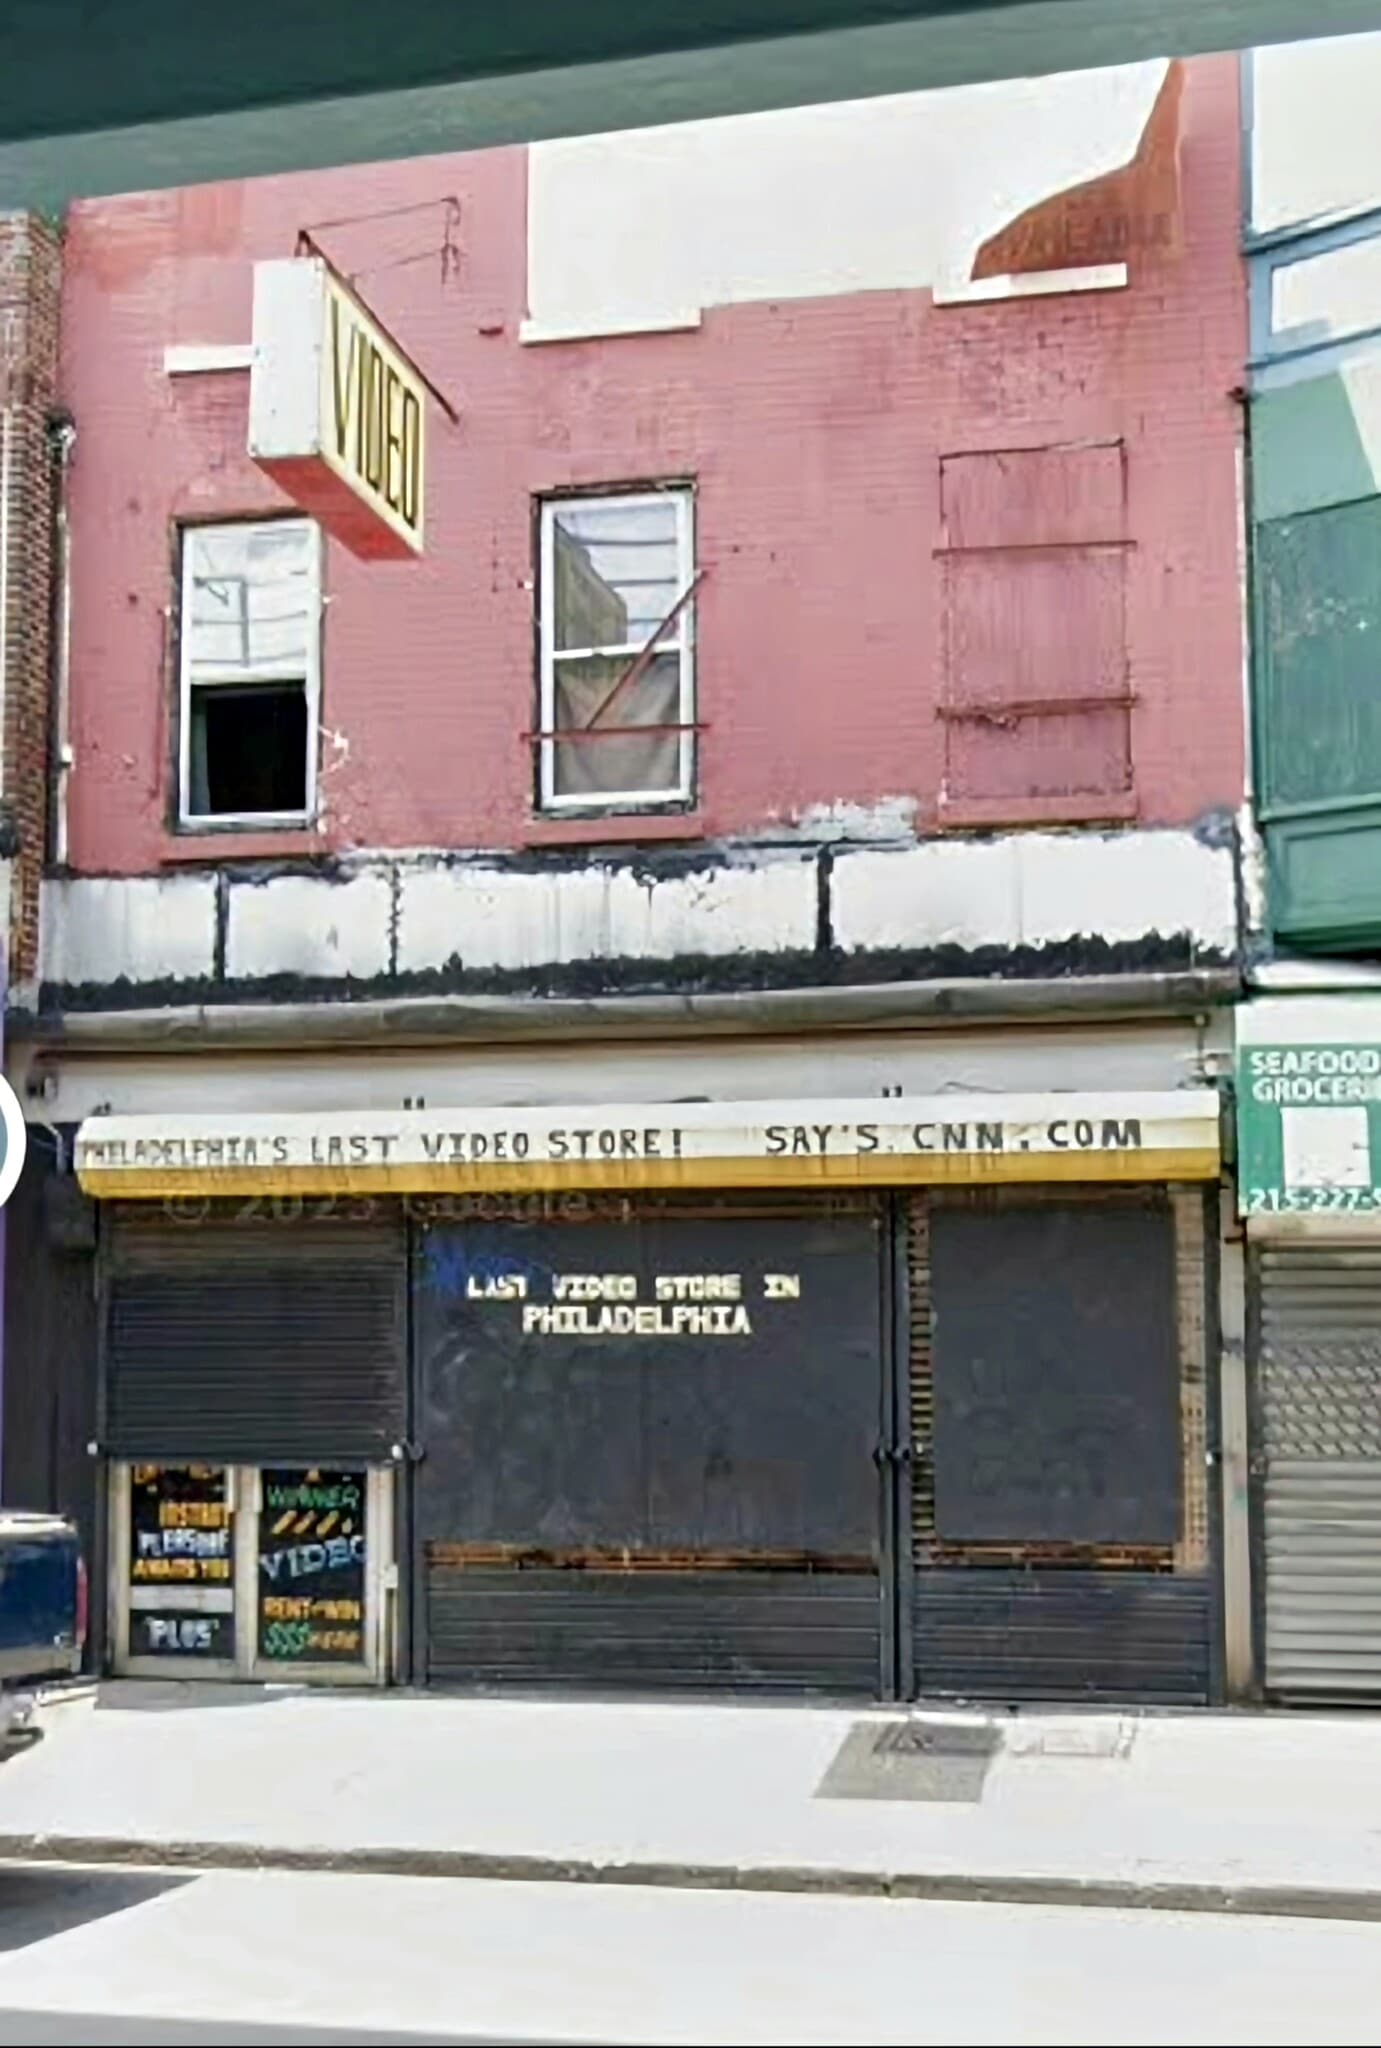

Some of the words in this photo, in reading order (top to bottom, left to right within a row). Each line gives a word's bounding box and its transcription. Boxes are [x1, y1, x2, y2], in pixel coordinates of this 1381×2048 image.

[331, 294, 421, 530] VIDEO
[1250, 1050, 1379, 1075] SEAFOOD
[311, 1134, 399, 1164] LAST
[422, 1130, 530, 1161] VIDEO
[548, 1127, 684, 1159] STORE!
[467, 1274, 529, 1299] LAST
[552, 1273, 637, 1300] VIDEO
[655, 1274, 741, 1300] STORE
[763, 1274, 800, 1299] IN
[522, 1305, 753, 1335] PHILADELPHIA
